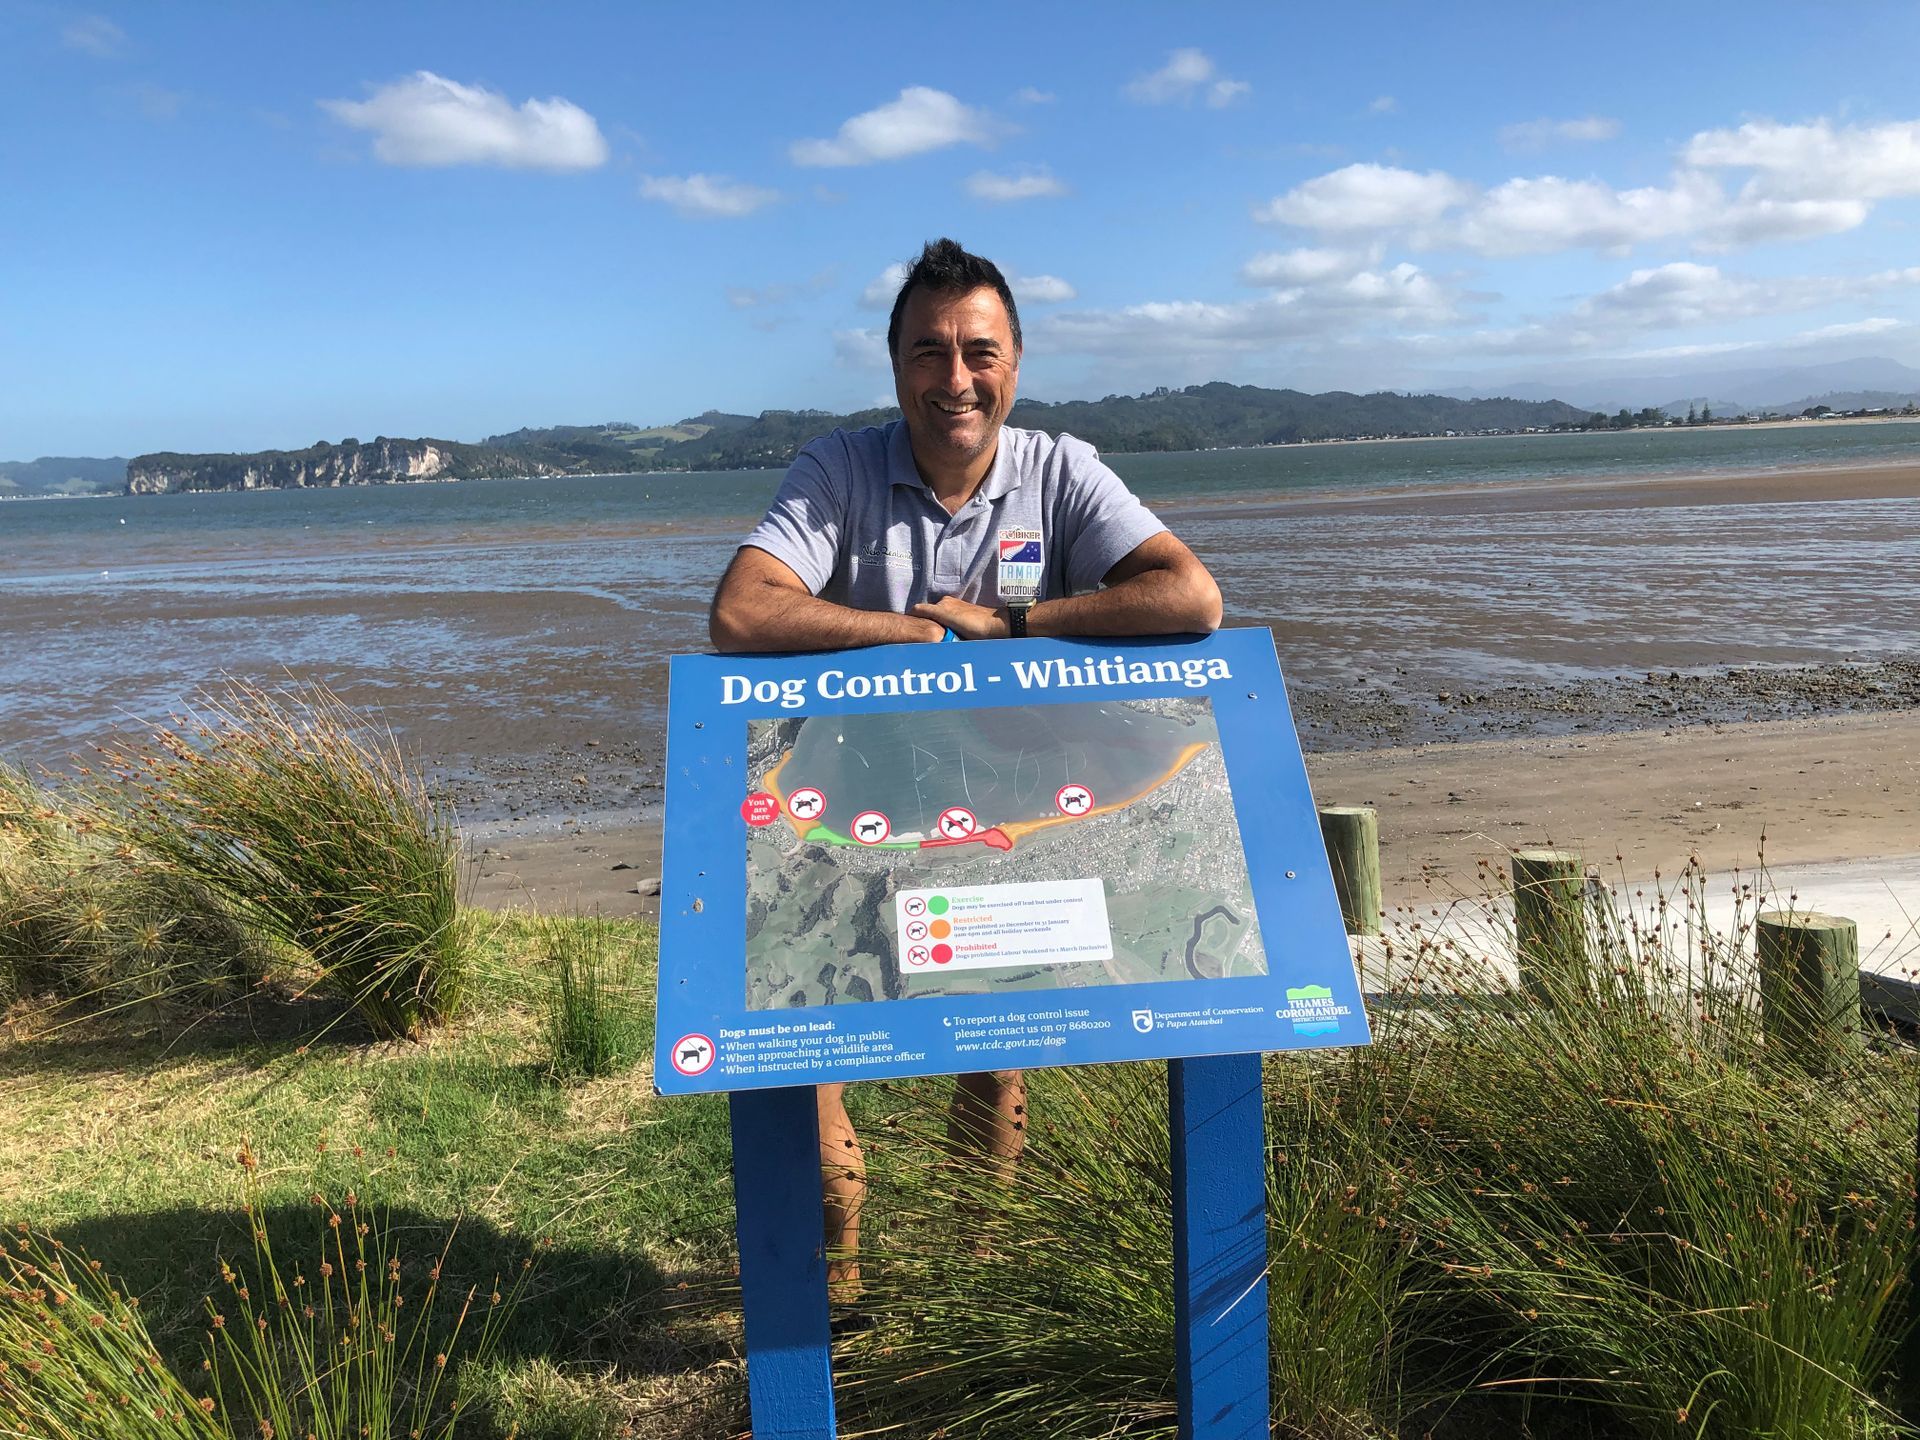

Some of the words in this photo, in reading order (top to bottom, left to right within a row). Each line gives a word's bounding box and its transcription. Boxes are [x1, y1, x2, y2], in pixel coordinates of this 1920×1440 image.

[1000, 565, 1040, 578] TAMAR
[1000, 586, 1040, 595] MOTOTOURS
[720, 675, 807, 708] Dog
[817, 662, 978, 698] Control
[1011, 656, 1232, 688] Whitianga
[954, 915, 992, 924] Restricted
[956, 943, 997, 952] Prohibited
[1288, 998, 1334, 1008] THAMES
[954, 1016, 966, 1025] To
[968, 1016, 997, 1026] report
[1007, 1012, 1025, 1023] dog
[1028, 1009, 1062, 1020] control
[1065, 1009, 1090, 1017] issue
[1154, 1010, 1200, 1020] Department
[1212, 1006, 1264, 1015] Conservation
[1276, 1006, 1351, 1018] COROMANDEL
[720, 1029, 746, 1039] Dogs
[749, 1026, 775, 1036] must
[778, 1024, 790, 1034] be
[793, 1025, 807, 1033] on
[809, 1021, 835, 1030] lead:
[955, 1029, 986, 1040] please
[988, 1026, 1024, 1036] contact
[1056, 1024, 1066, 1033] 07
[1069, 1020, 1111, 1030] 8680200
[1167, 1020, 1187, 1029] Papa
[726, 1041, 755, 1051] When
[758, 1038, 798, 1048] walking
[800, 1037, 822, 1047] your
[826, 1034, 844, 1045] dog
[846, 1034, 856, 1043] in
[859, 1030, 890, 1043] public
[956, 1036, 1066, 1051] www.tcdc.govt.nz/dogs
[726, 1052, 755, 1063] When
[758, 1048, 820, 1062] approaching
[832, 1042, 870, 1055] wildlife
[872, 1043, 893, 1052] area
[726, 1064, 755, 1074] When
[758, 1060, 809, 1072] instructed
[812, 1058, 824, 1069] by
[834, 1054, 892, 1067] compliance
[894, 1052, 926, 1062] officer
